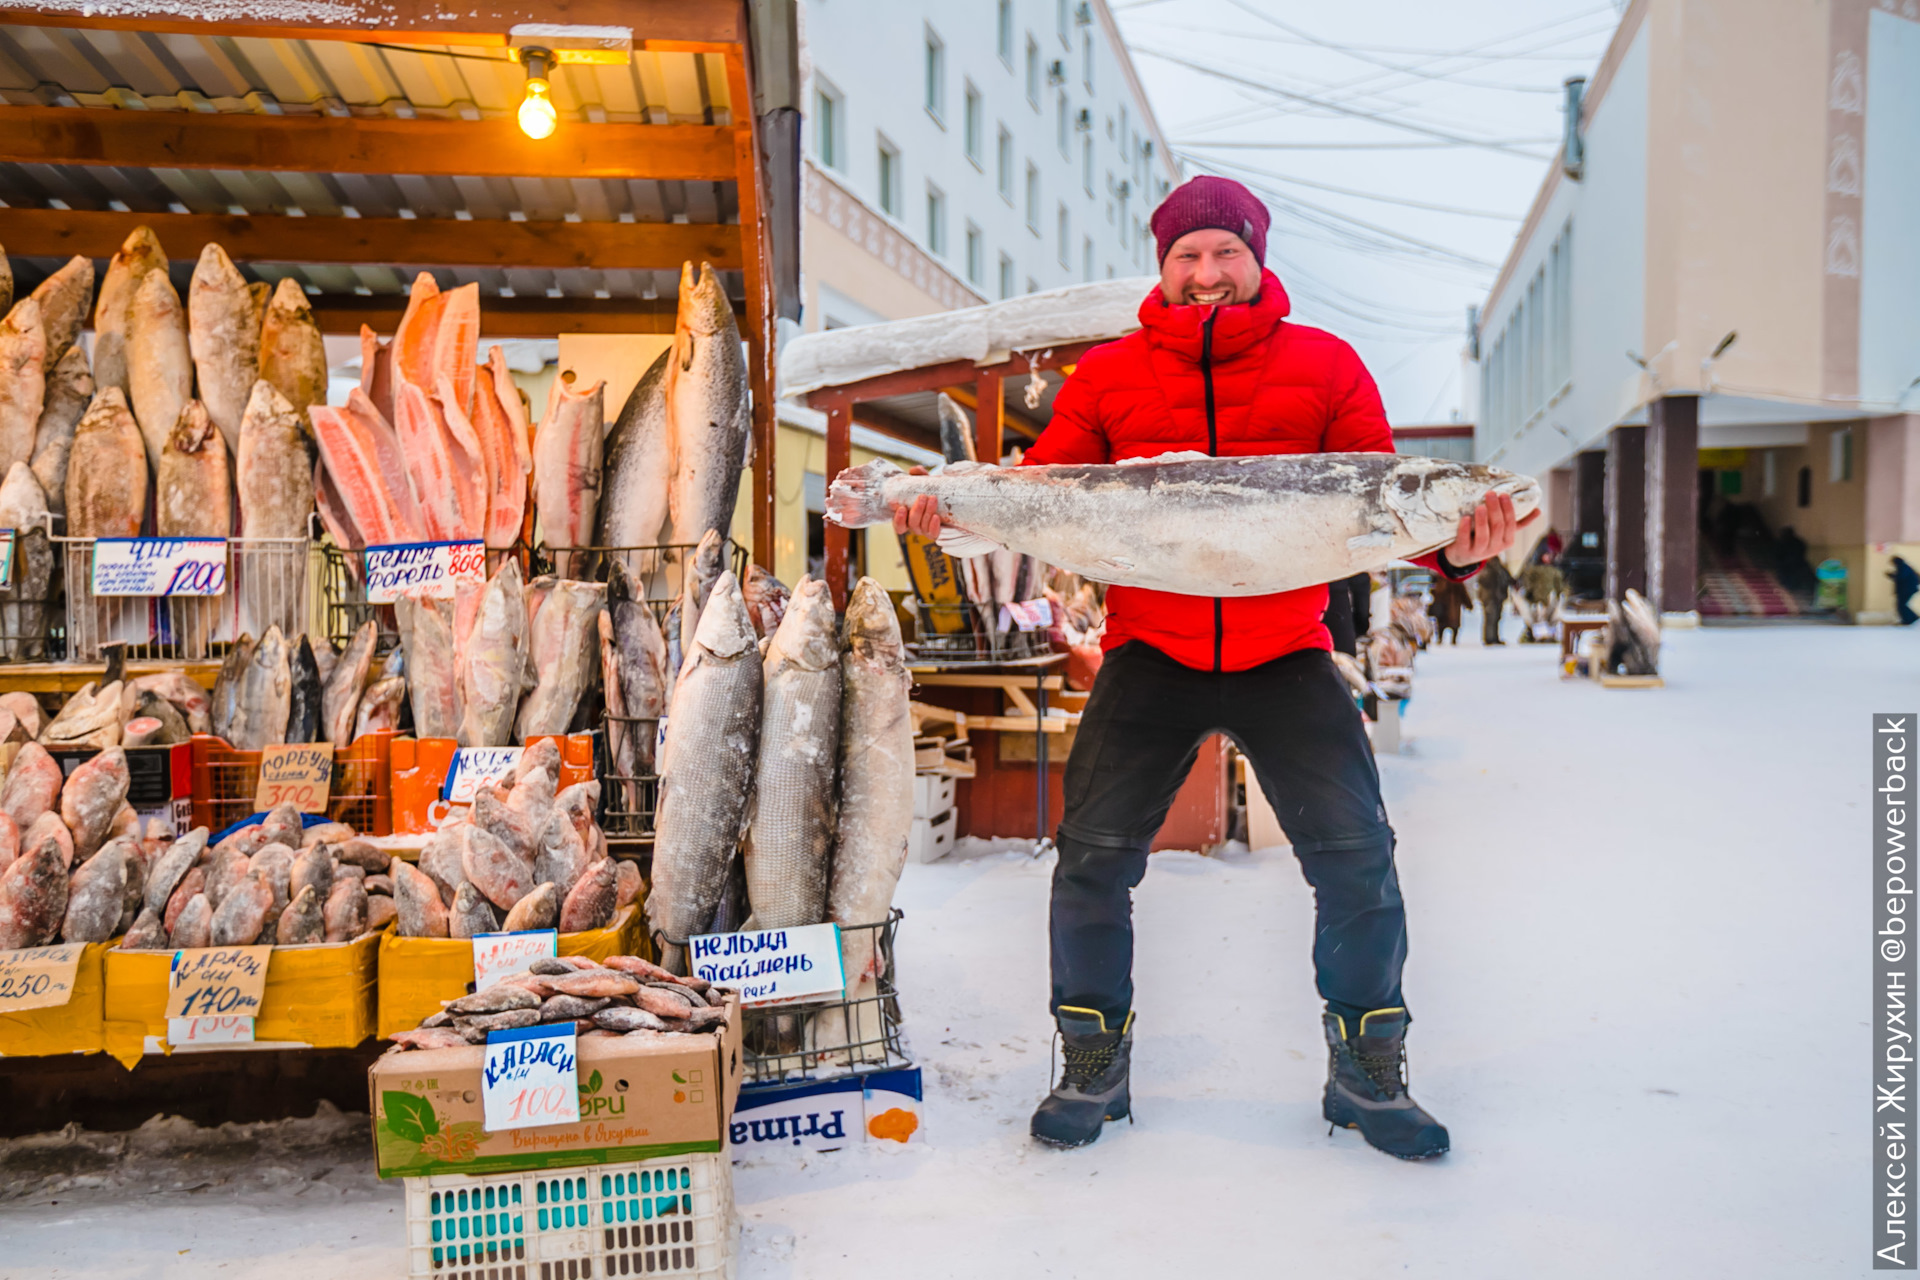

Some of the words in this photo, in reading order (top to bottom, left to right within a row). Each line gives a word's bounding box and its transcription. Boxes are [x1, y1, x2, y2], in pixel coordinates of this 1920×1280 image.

[164, 559, 226, 596] 1200
[367, 564, 444, 592] ФОРЕЛЬ
[448, 554, 487, 577] 800
[264, 785, 314, 808] 300
[176, 950, 261, 988] КАРАСИ
[0, 974, 50, 998] 250
[180, 985, 241, 1016] 170
[484, 1041, 576, 1090] КАРАСИ
[506, 1084, 567, 1122] 100
[509, 1128, 580, 1150] Выращено
[584, 1125, 593, 1143] в
[595, 1122, 650, 1145] Якутии
[729, 1110, 846, 1146] Prima
